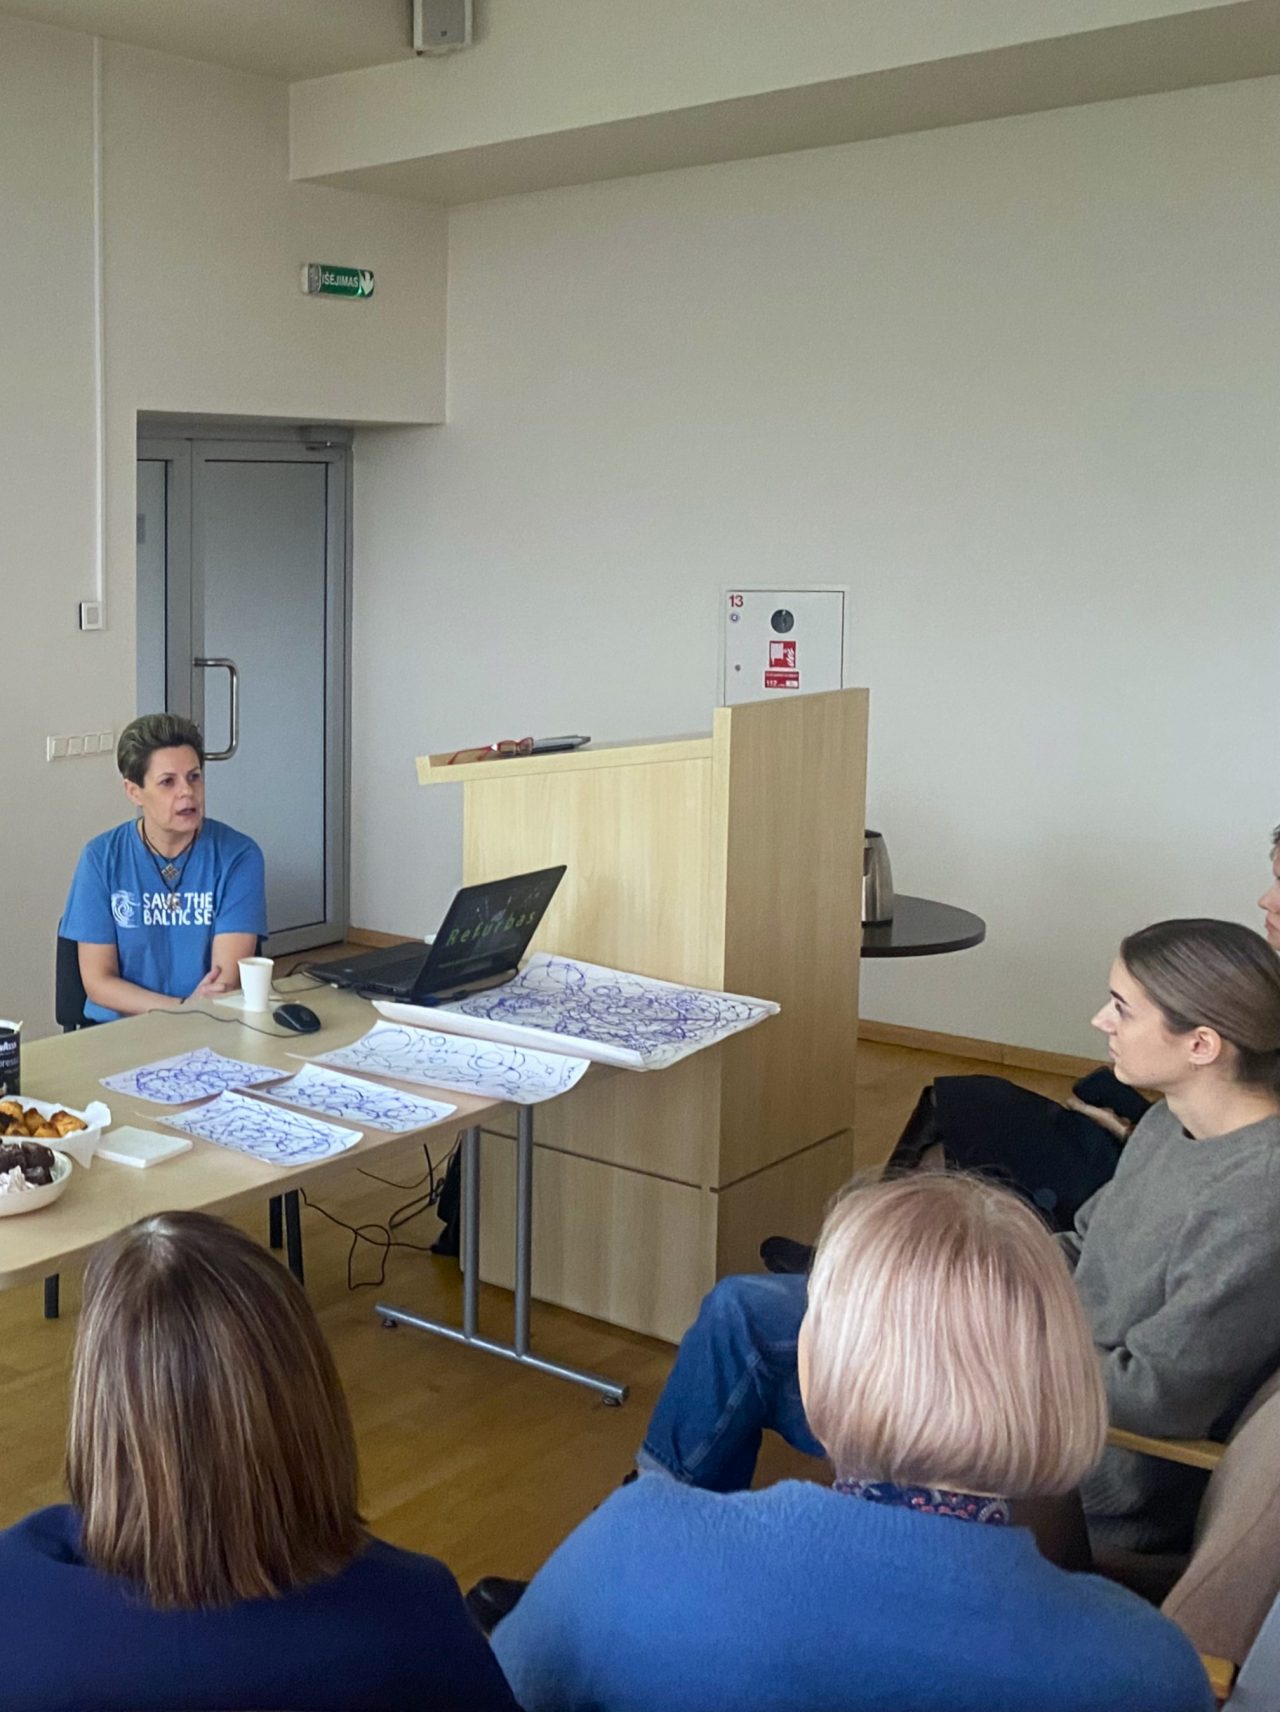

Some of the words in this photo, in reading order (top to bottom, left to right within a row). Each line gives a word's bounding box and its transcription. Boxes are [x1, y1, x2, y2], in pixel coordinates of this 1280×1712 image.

[728, 594, 744, 607] 13
[184, 891, 213, 910] THE
[143, 909, 191, 925] BALTIC
[194, 909, 215, 925] SE
